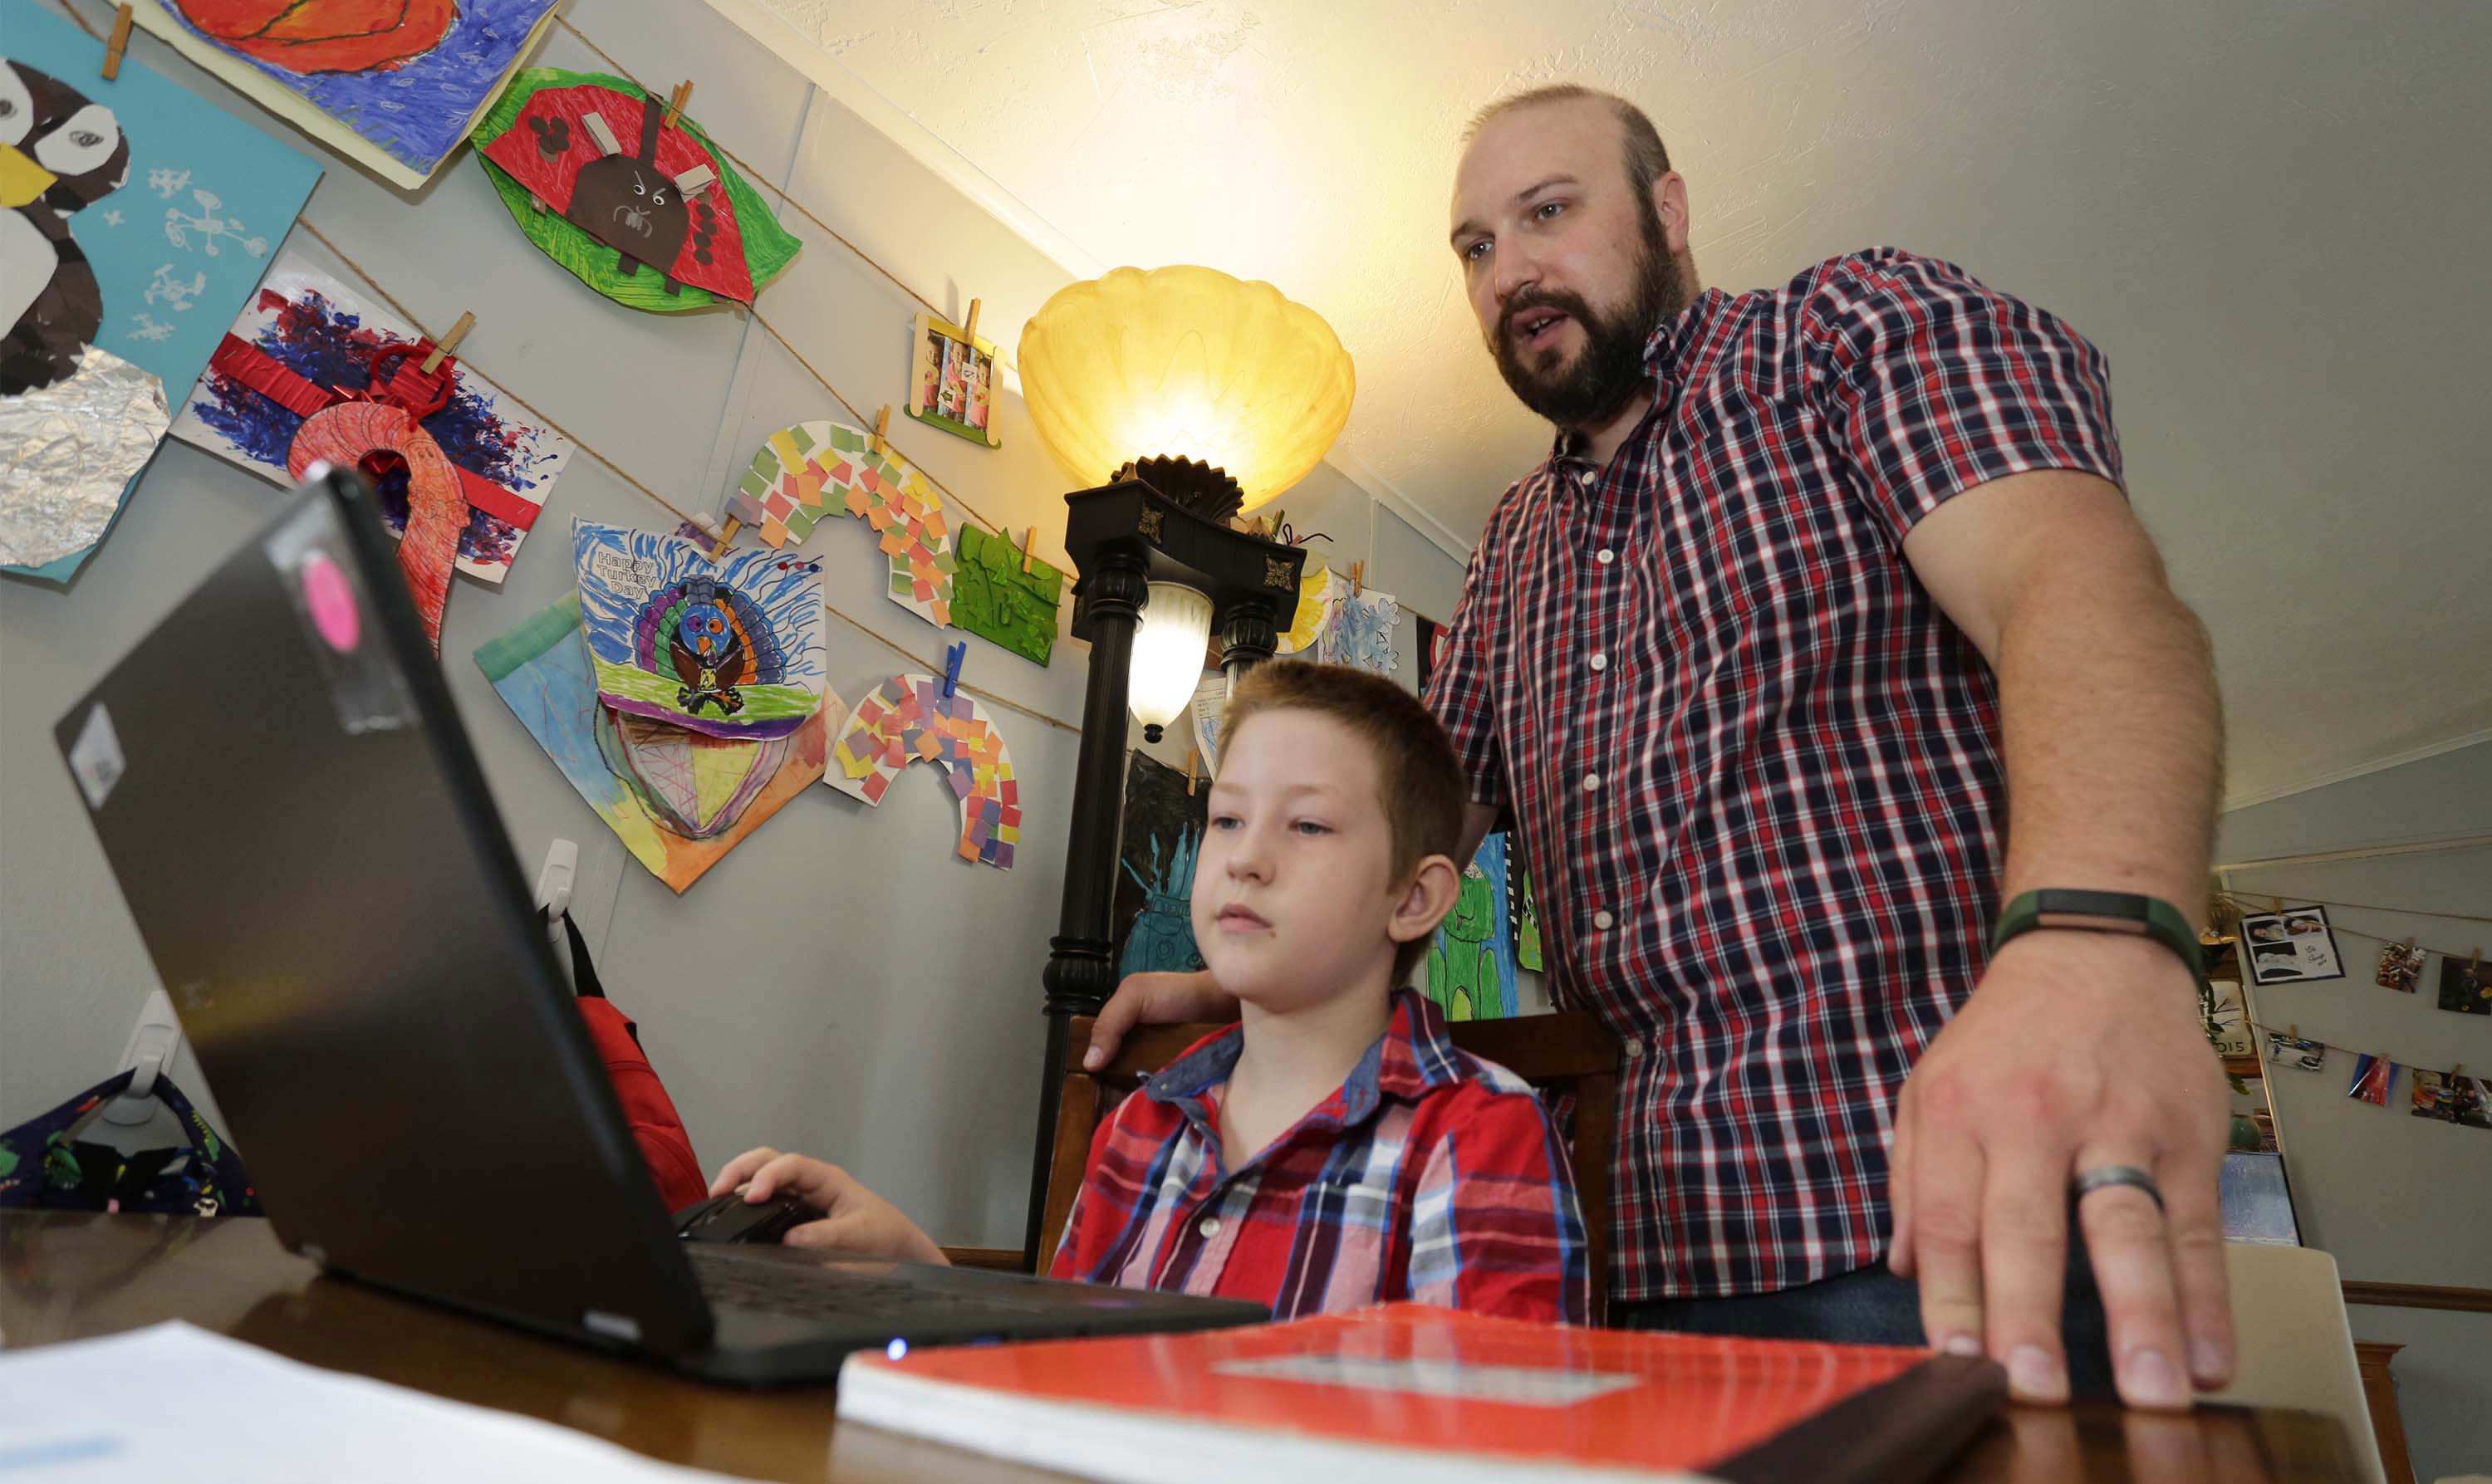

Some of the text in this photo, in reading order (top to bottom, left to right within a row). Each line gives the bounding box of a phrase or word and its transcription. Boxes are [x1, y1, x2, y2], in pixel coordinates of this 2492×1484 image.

[598, 551, 653, 574] Happy
[597, 564, 656, 588] Turkey
[611, 580, 644, 600] Day
[2215, 1041, 2244, 1053] 015
